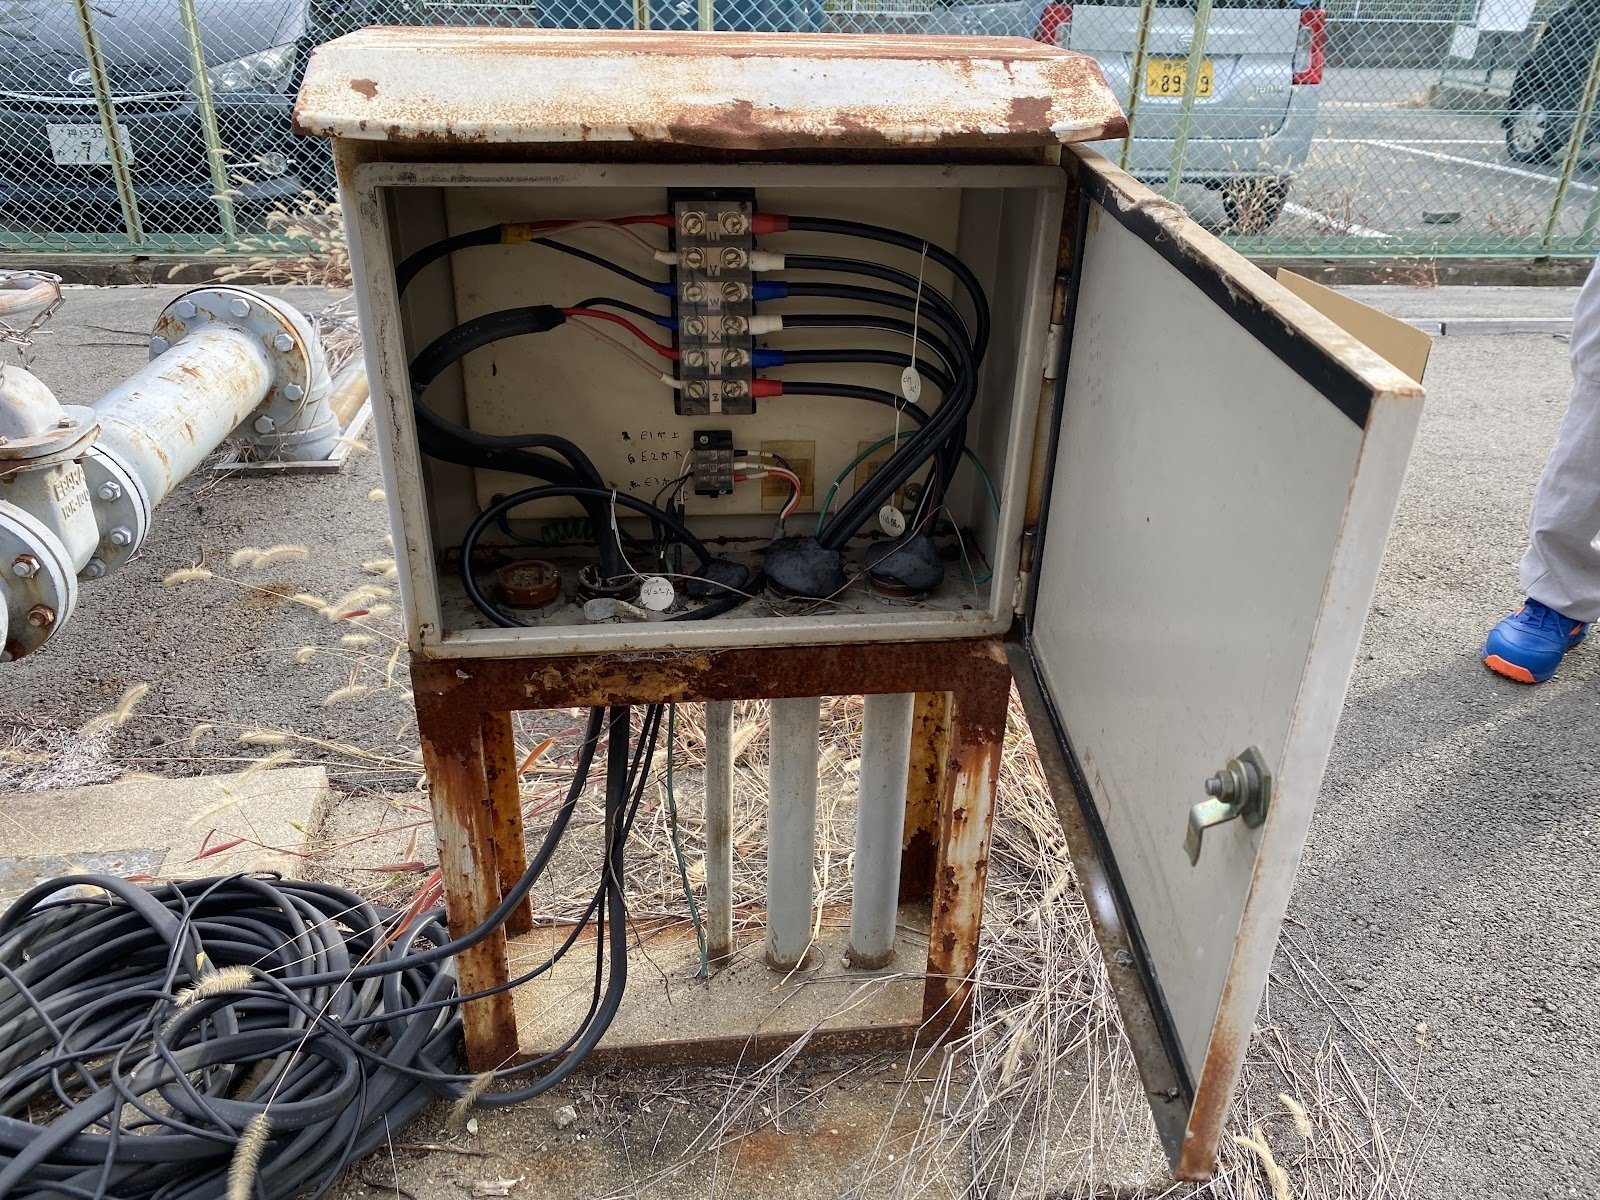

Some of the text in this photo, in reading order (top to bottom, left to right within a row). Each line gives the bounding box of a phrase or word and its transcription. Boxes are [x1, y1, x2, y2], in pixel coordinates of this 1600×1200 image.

[1161, 75, 1209, 93] 899
[709, 264, 717, 275] V
[709, 299, 720, 309] W
[711, 331, 720, 341] X
[710, 361, 719, 373] Y
